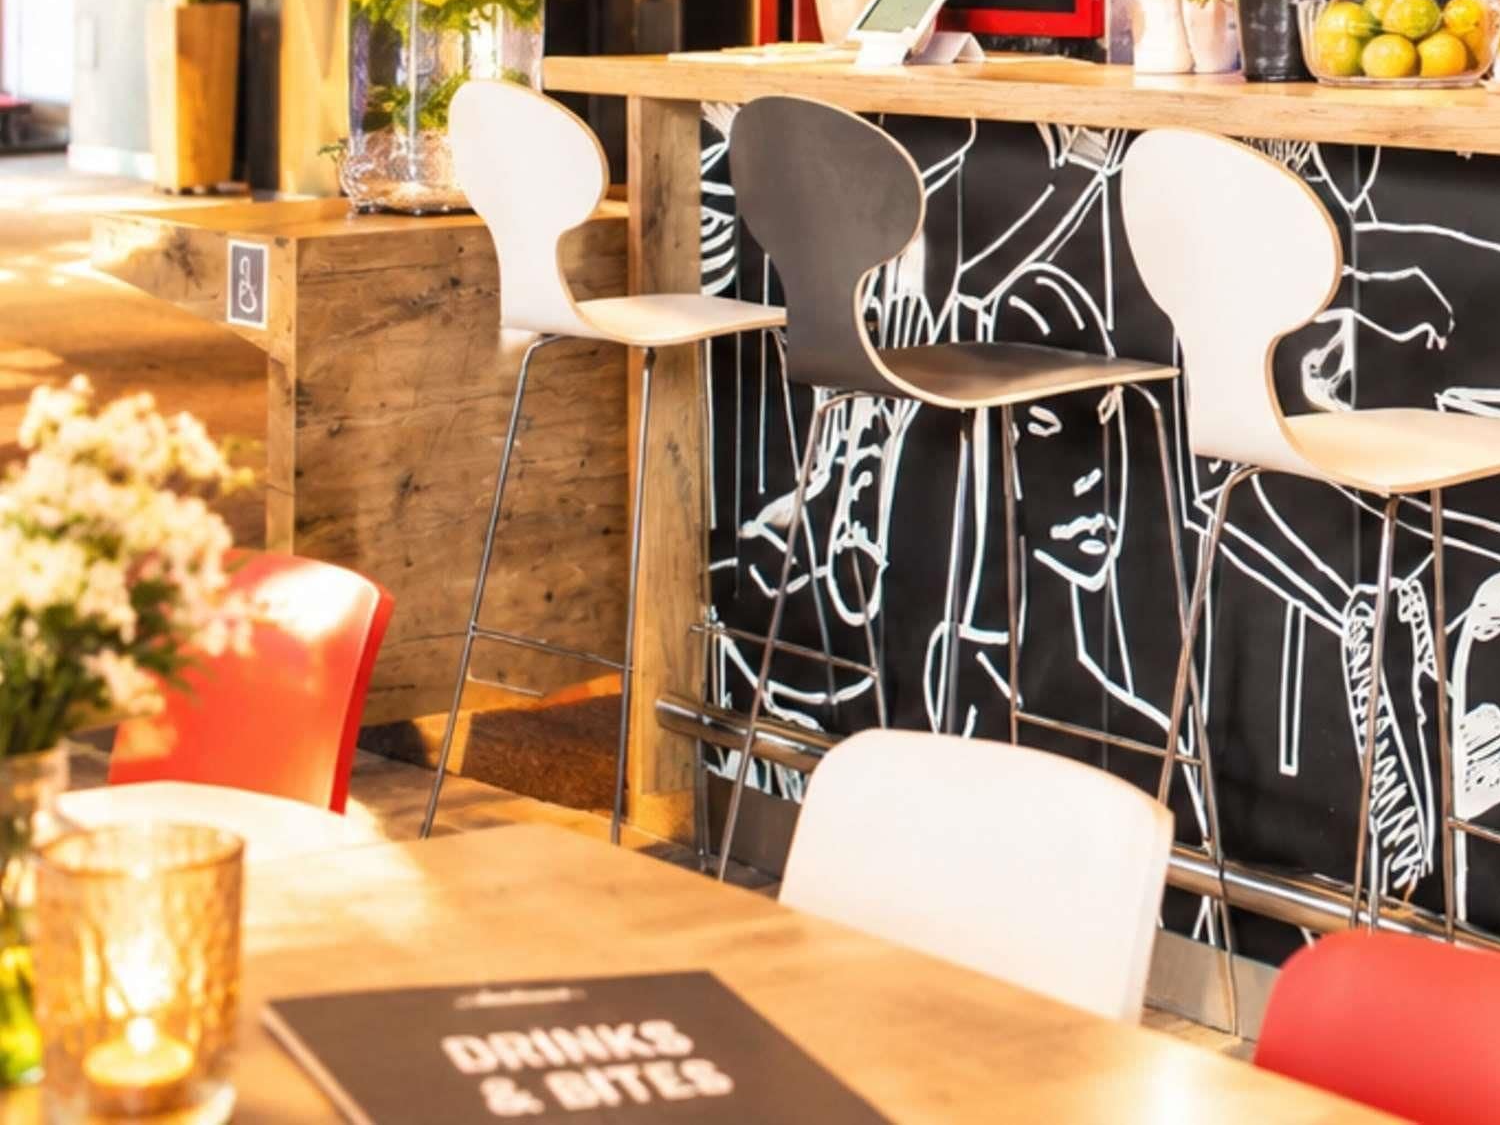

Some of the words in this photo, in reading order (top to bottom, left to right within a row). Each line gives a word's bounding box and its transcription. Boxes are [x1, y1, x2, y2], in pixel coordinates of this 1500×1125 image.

[441, 1019, 694, 1075] DRINKS
[479, 1075, 546, 1118] &
[543, 1058, 735, 1112] BITES
